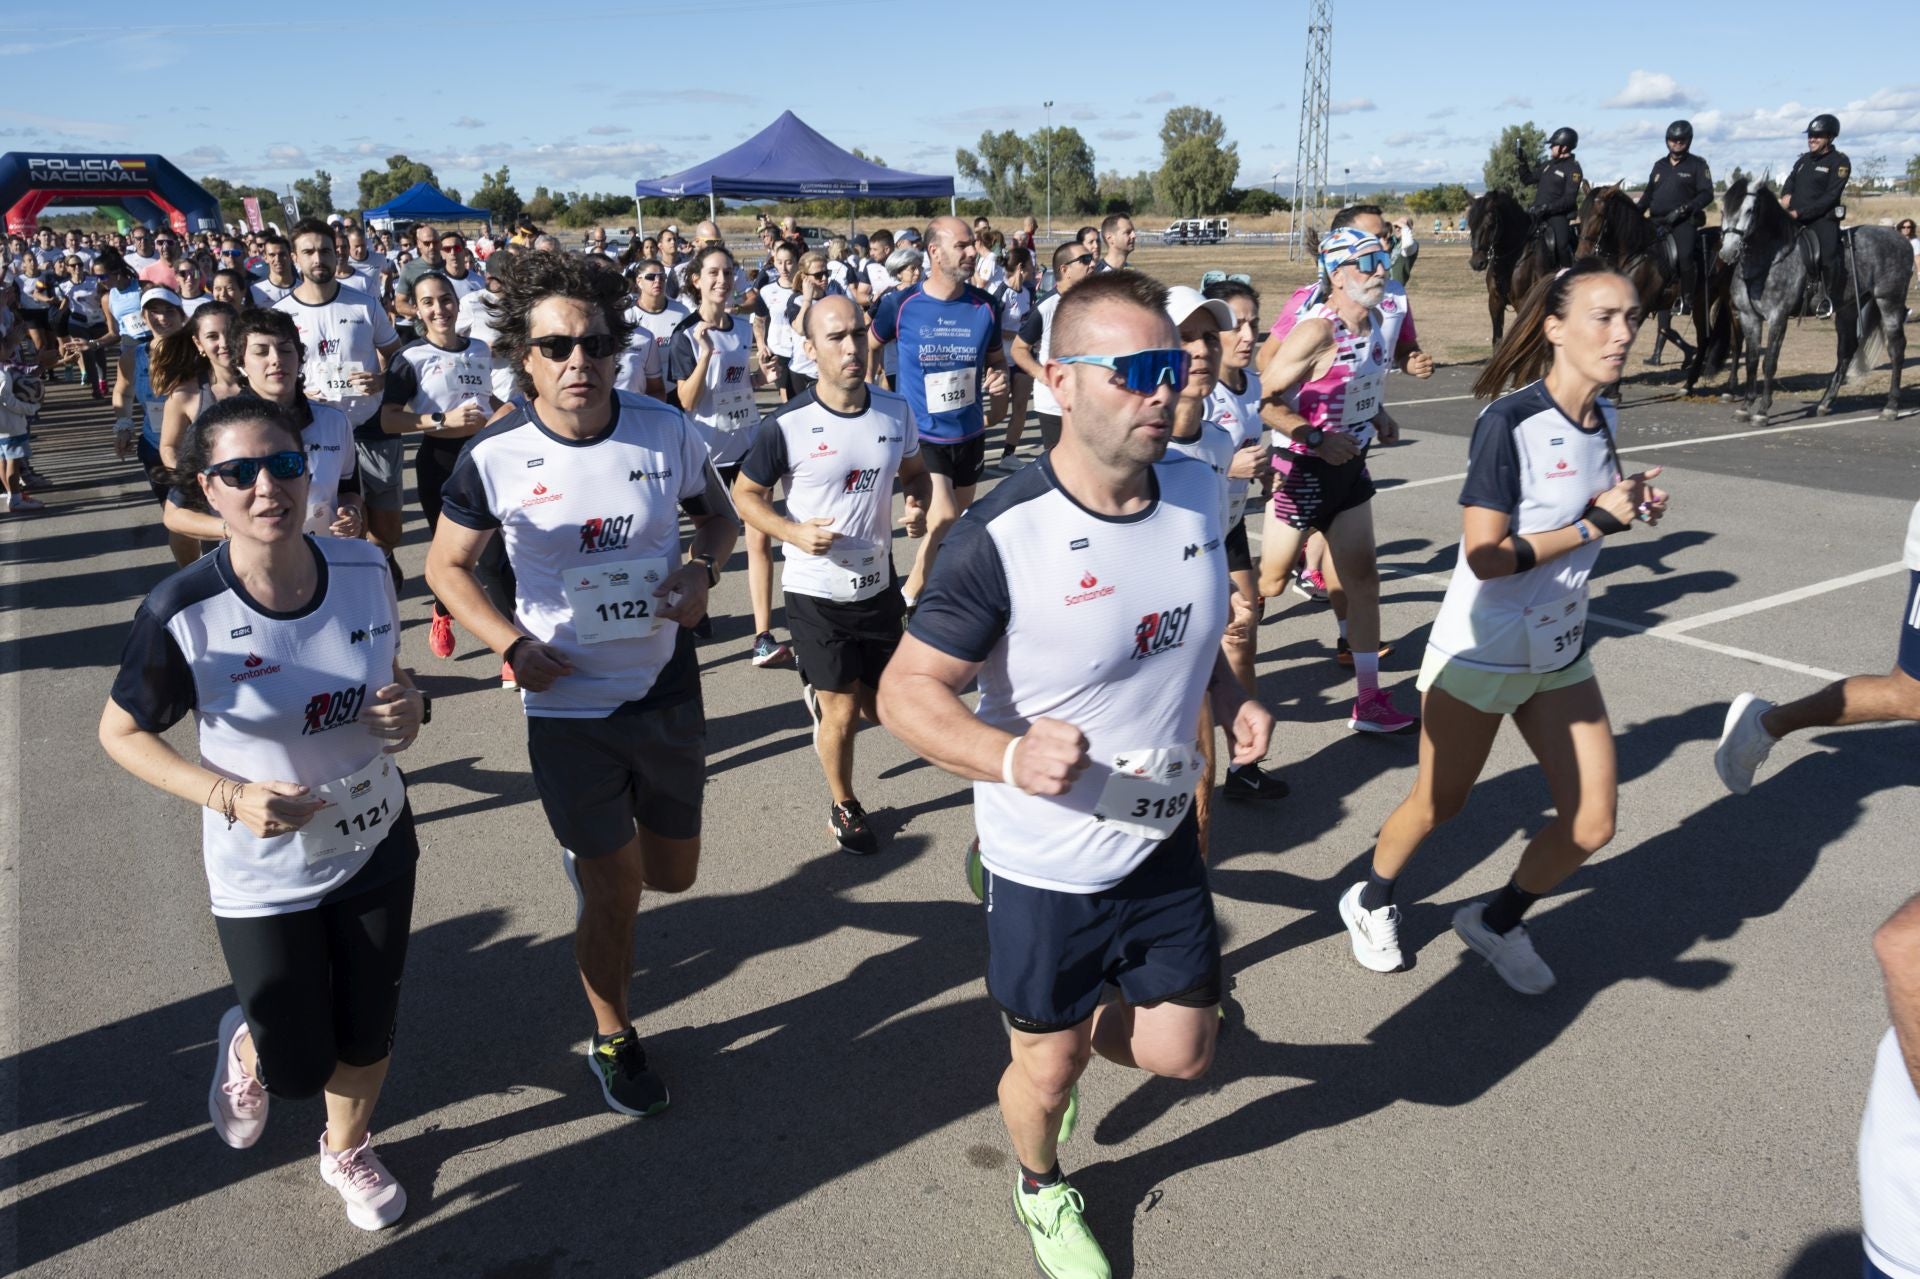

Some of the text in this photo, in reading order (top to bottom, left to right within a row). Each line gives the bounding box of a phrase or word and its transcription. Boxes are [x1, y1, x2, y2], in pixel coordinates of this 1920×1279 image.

[28, 158, 123, 171] POLICIA
[30, 170, 148, 183] NACIONAL
[919, 343, 977, 354] MD Anderson
[919, 352, 977, 362] Cancer Center
[458, 374, 482, 385] 1325
[941, 389, 966, 403] 1328
[1355, 397, 1376, 412] 1397
[728, 408, 749, 420] 1417
[521, 493, 564, 508] Santander
[850, 571, 881, 590] 1392
[1064, 585, 1116, 607] Santander
[596, 599, 650, 622] 1122
[230, 665, 281, 683] Santander
[1131, 792, 1188, 819] 3189
[334, 797, 389, 836] 1121
